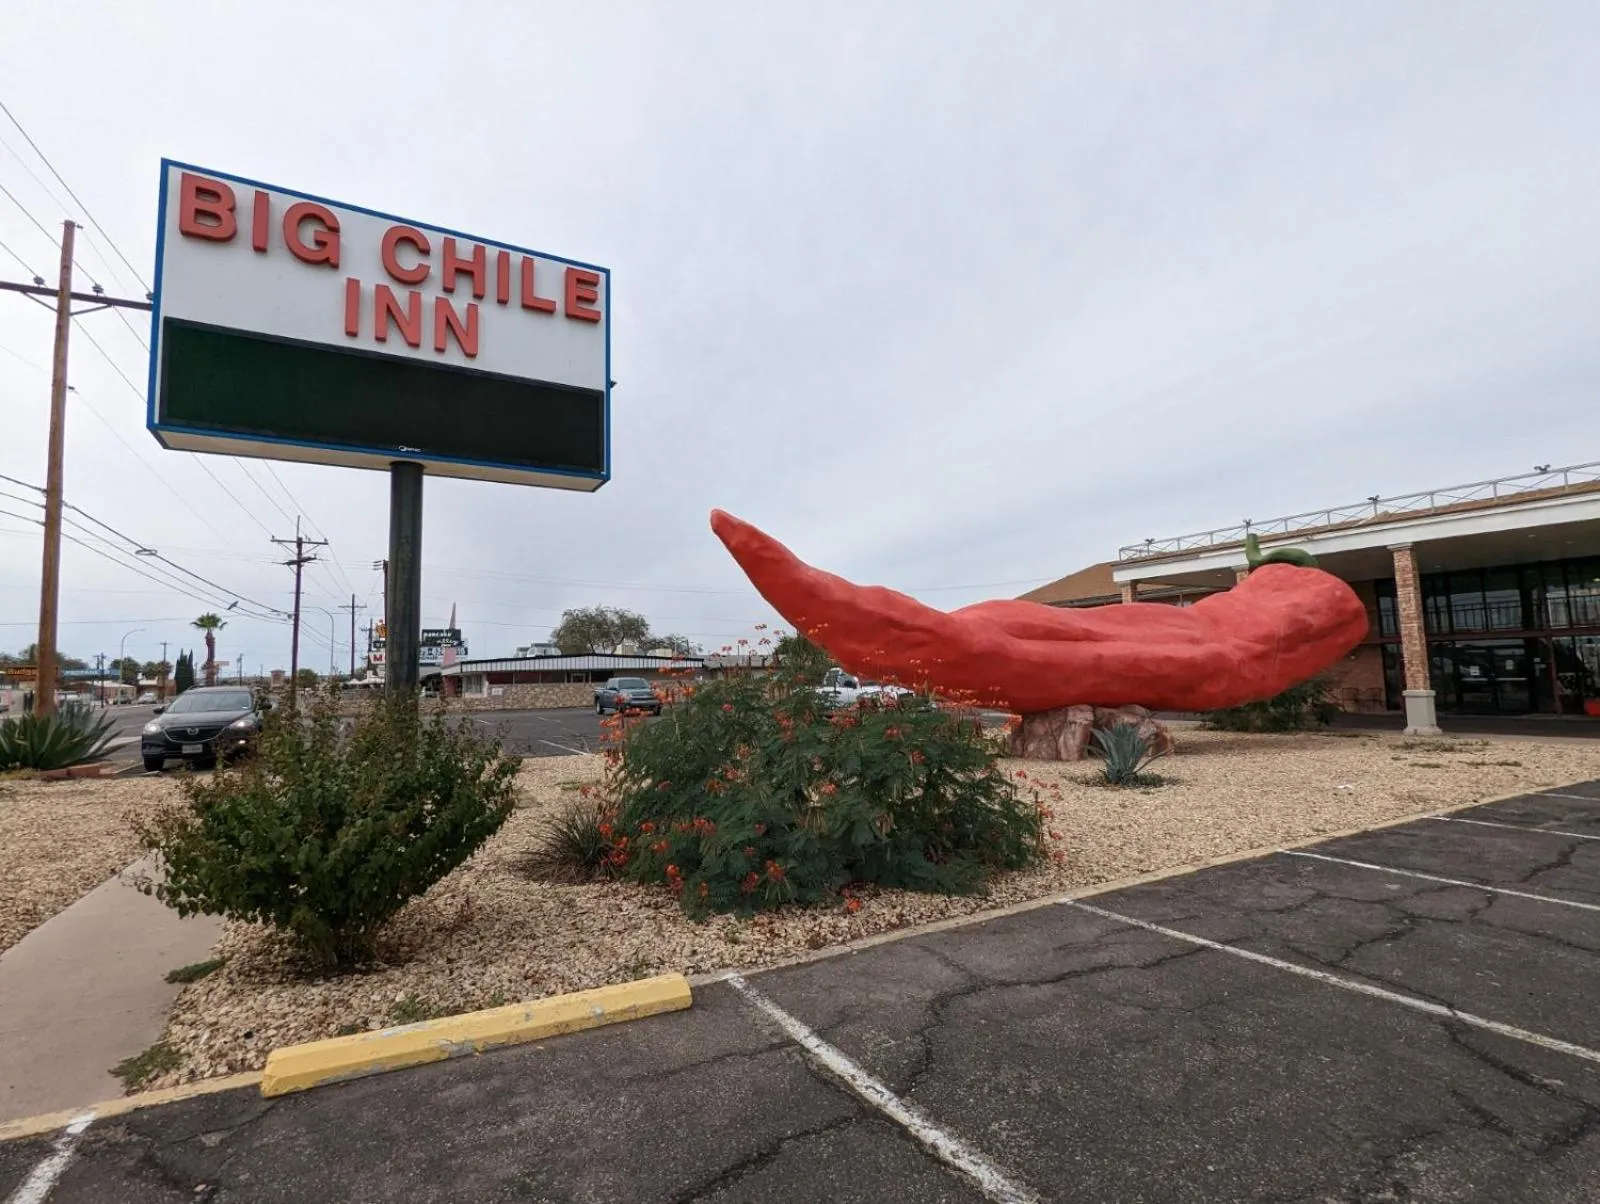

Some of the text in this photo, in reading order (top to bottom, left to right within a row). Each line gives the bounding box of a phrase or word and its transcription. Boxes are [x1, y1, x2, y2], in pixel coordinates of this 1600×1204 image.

[179, 172, 601, 323] BIG CHILE
[344, 277, 479, 358] INN
